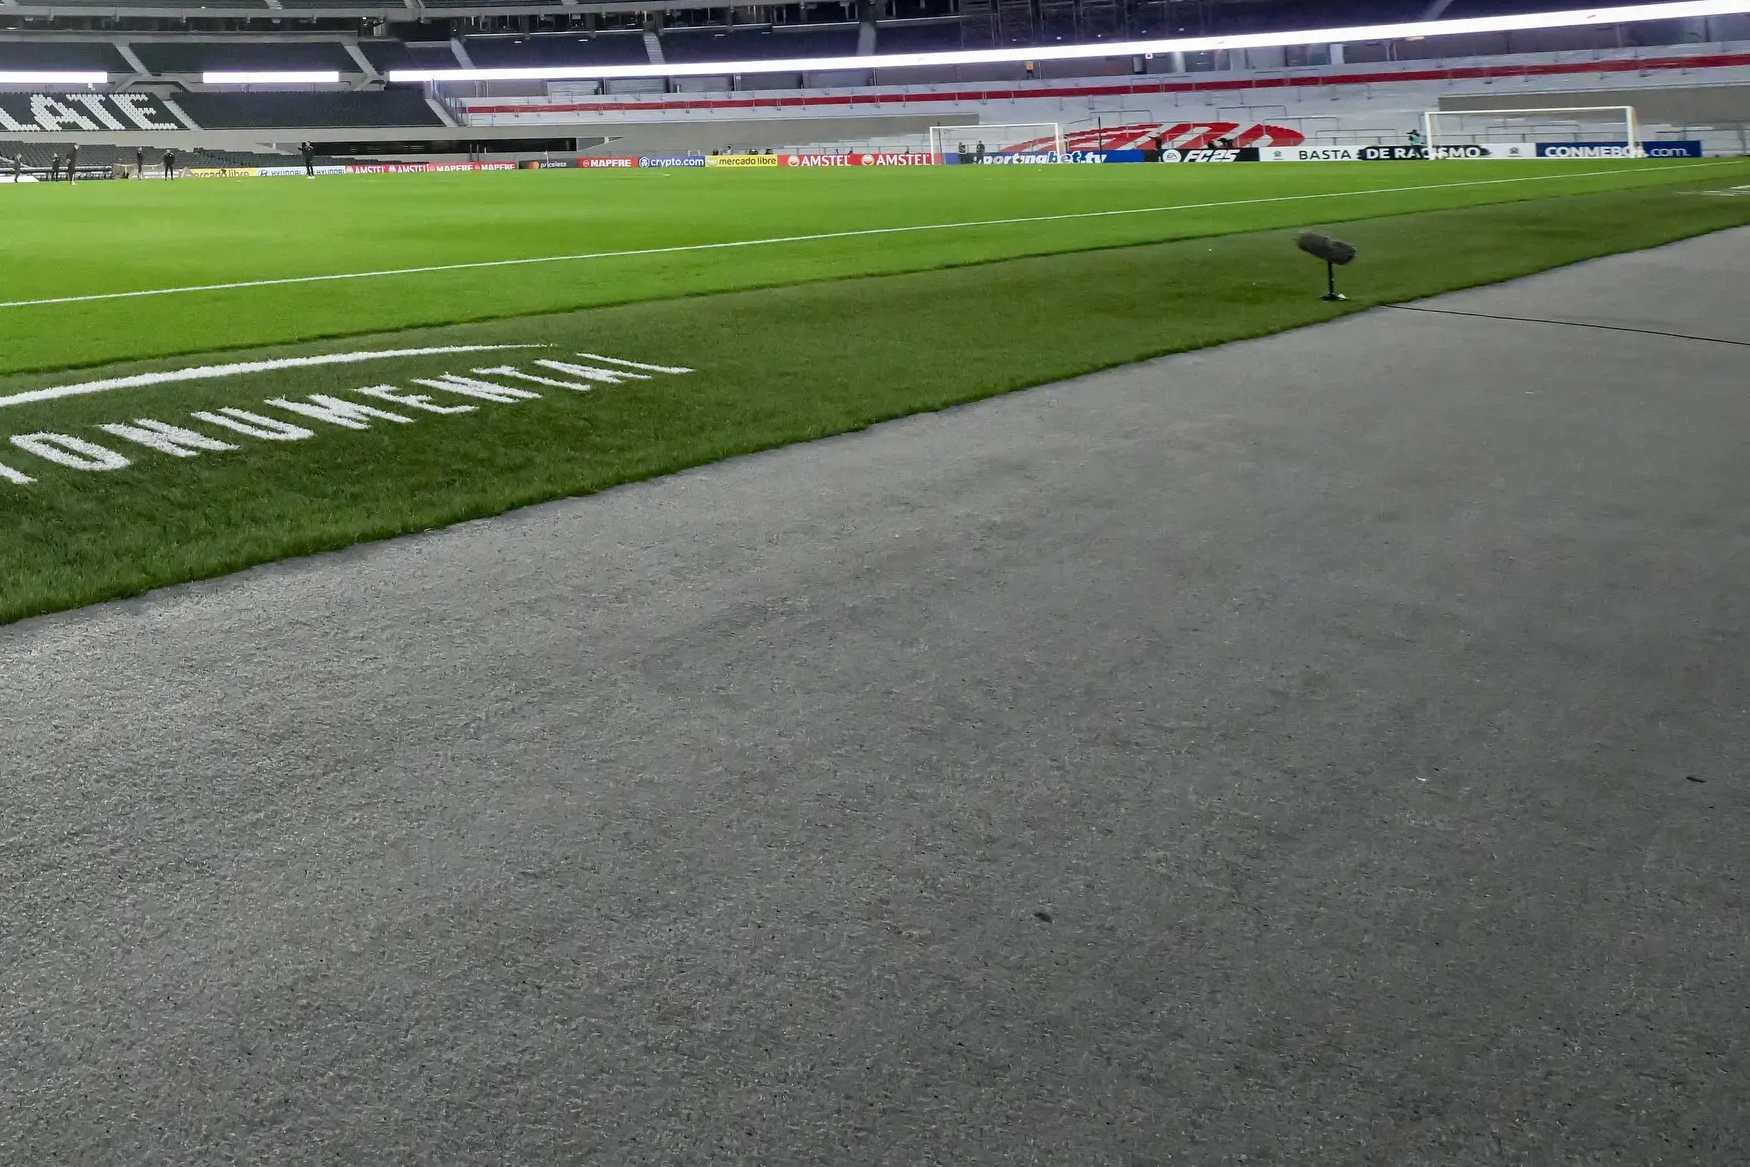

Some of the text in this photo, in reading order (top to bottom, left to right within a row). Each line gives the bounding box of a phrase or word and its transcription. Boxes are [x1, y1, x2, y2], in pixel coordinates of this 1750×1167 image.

[1184, 149, 1237, 162] FC25
[1299, 147, 1481, 160] BASTA DE RACSMO
[591, 159, 631, 167] MAPFRE
[650, 156, 703, 167] crypto.com
[718, 156, 776, 166] mercado libre
[802, 155, 850, 166] AMSTEL
[877, 154, 929, 165] AMSTEL
[436, 164, 473, 172] MAPFRE
[480, 163, 515, 171] MAPFRE
[540, 161, 567, 169] priceless
[193, 169, 226, 178] ercado
